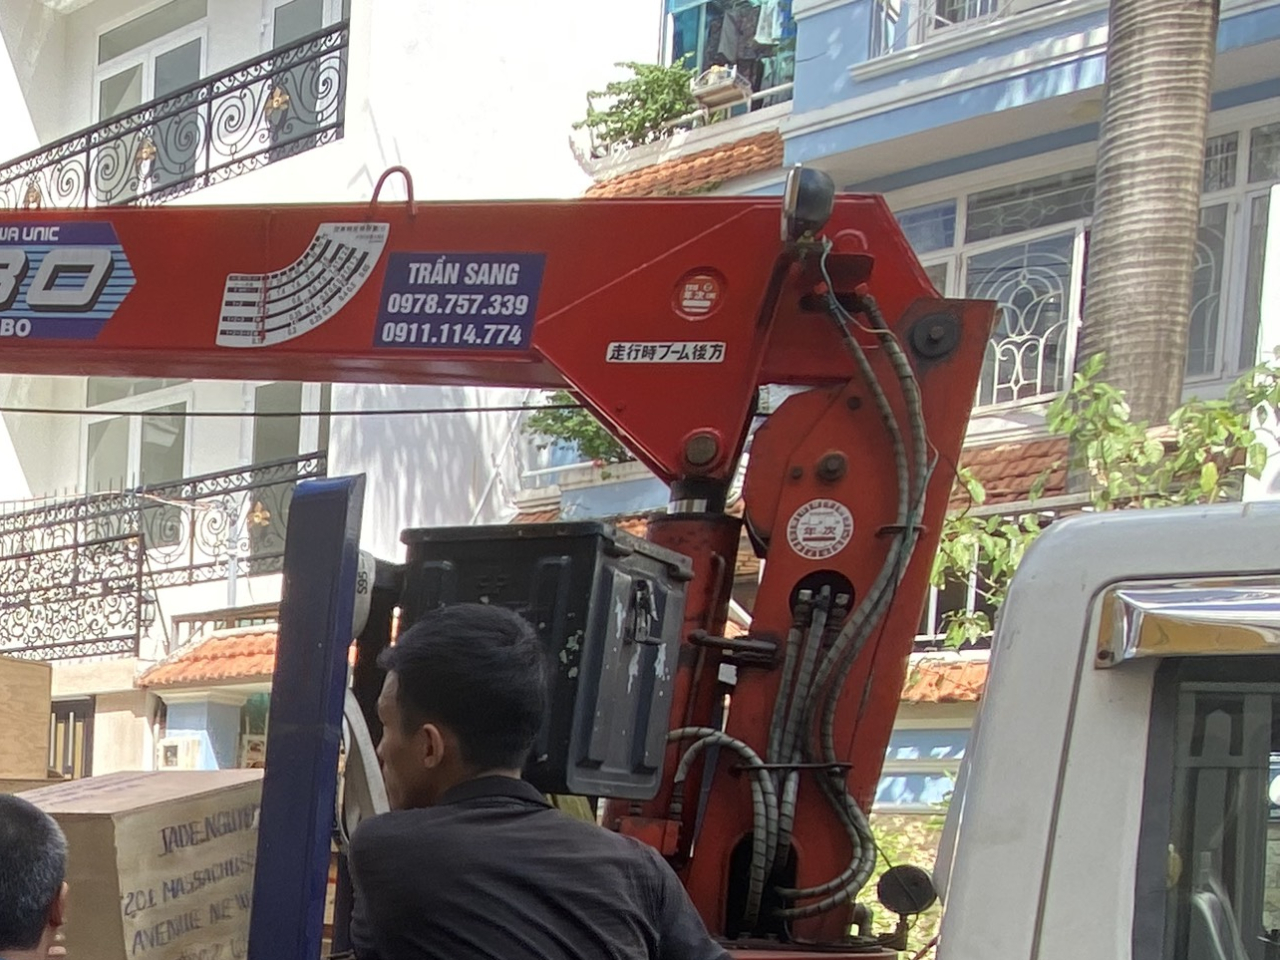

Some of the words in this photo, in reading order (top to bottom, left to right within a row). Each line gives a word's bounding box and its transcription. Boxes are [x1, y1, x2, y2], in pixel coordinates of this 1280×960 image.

[23, 226, 60, 242] UNIC
[464, 262, 520, 286] SANG
[387, 293, 529, 316] 0978.757.339
[382, 322, 522, 345] 0911.114.774
